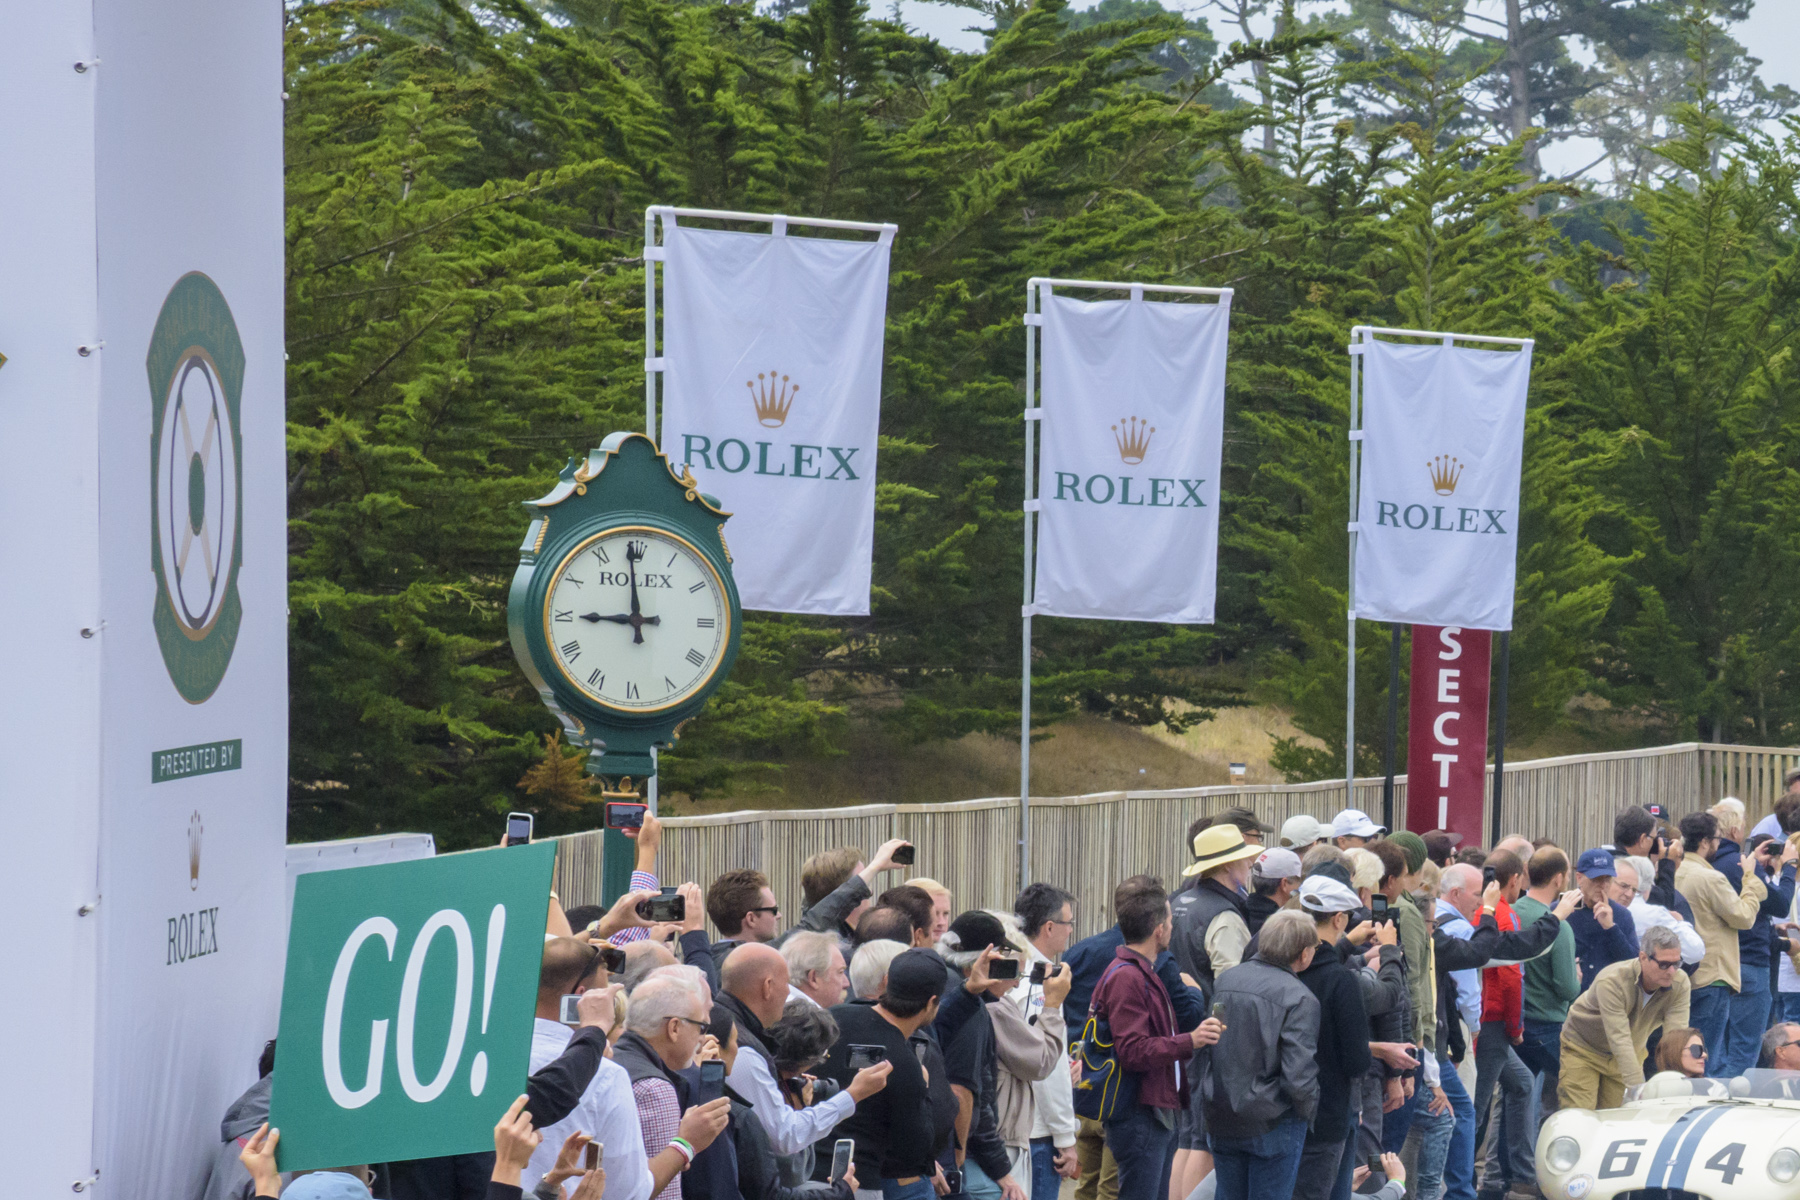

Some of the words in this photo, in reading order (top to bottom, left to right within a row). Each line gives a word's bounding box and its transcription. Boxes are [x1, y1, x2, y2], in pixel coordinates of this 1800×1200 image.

[680, 434, 860, 481] ROLEX
[1053, 471, 1207, 508] ROLEX
[1376, 501, 1508, 535] ROLEX
[592, 546, 610, 567] XI
[565, 573, 584, 589] X
[555, 609, 573, 623] IX
[159, 747, 217, 776] PRESENTED
[221, 745, 234, 766] BY
[166, 907, 219, 966] ROLEX
[322, 903, 507, 1109] GO!
[1597, 1139, 1648, 1180] 6
[1704, 1142, 1747, 1186] 4
